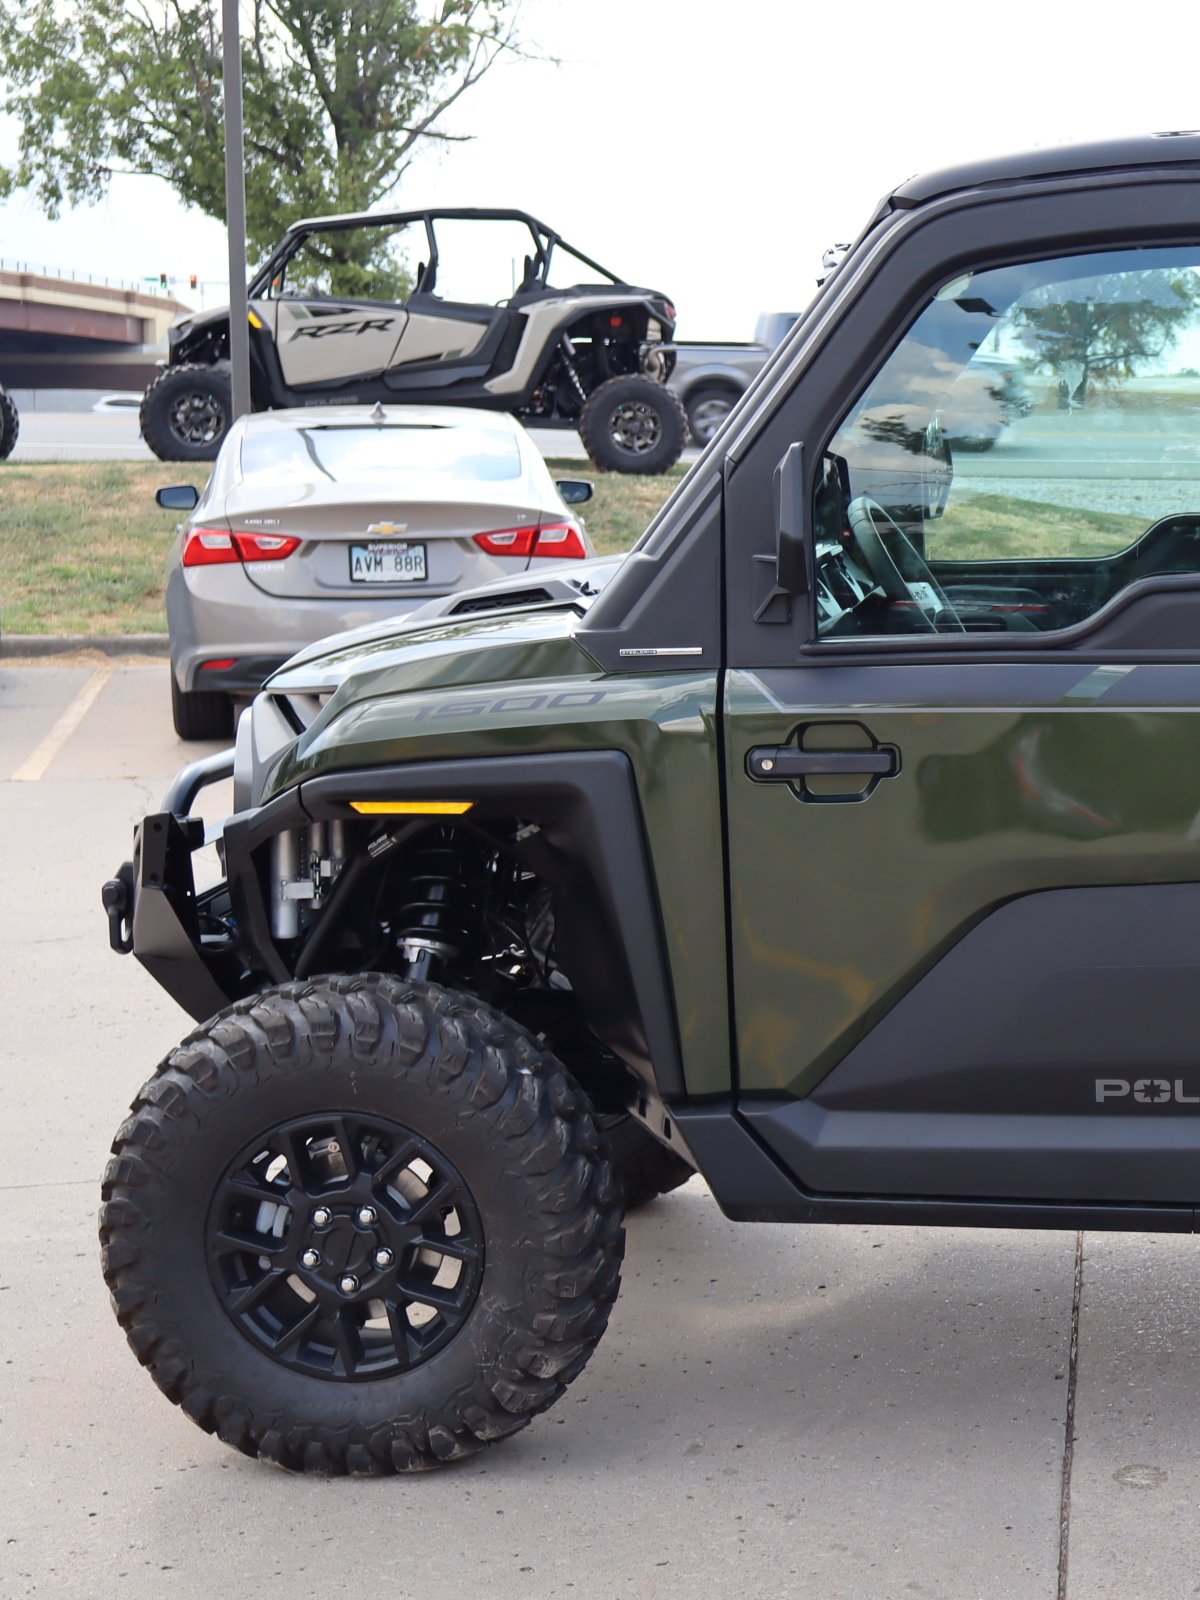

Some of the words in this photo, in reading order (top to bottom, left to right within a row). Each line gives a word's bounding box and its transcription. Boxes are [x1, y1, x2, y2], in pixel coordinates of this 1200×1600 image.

[287, 318, 396, 344] RZR
[367, 542, 408, 551] SUPERIOR
[248, 562, 285, 572] SUPERIOR
[354, 556, 384, 573] AVM
[394, 555, 423, 573] 88R
[411, 690, 608, 722] 1500
